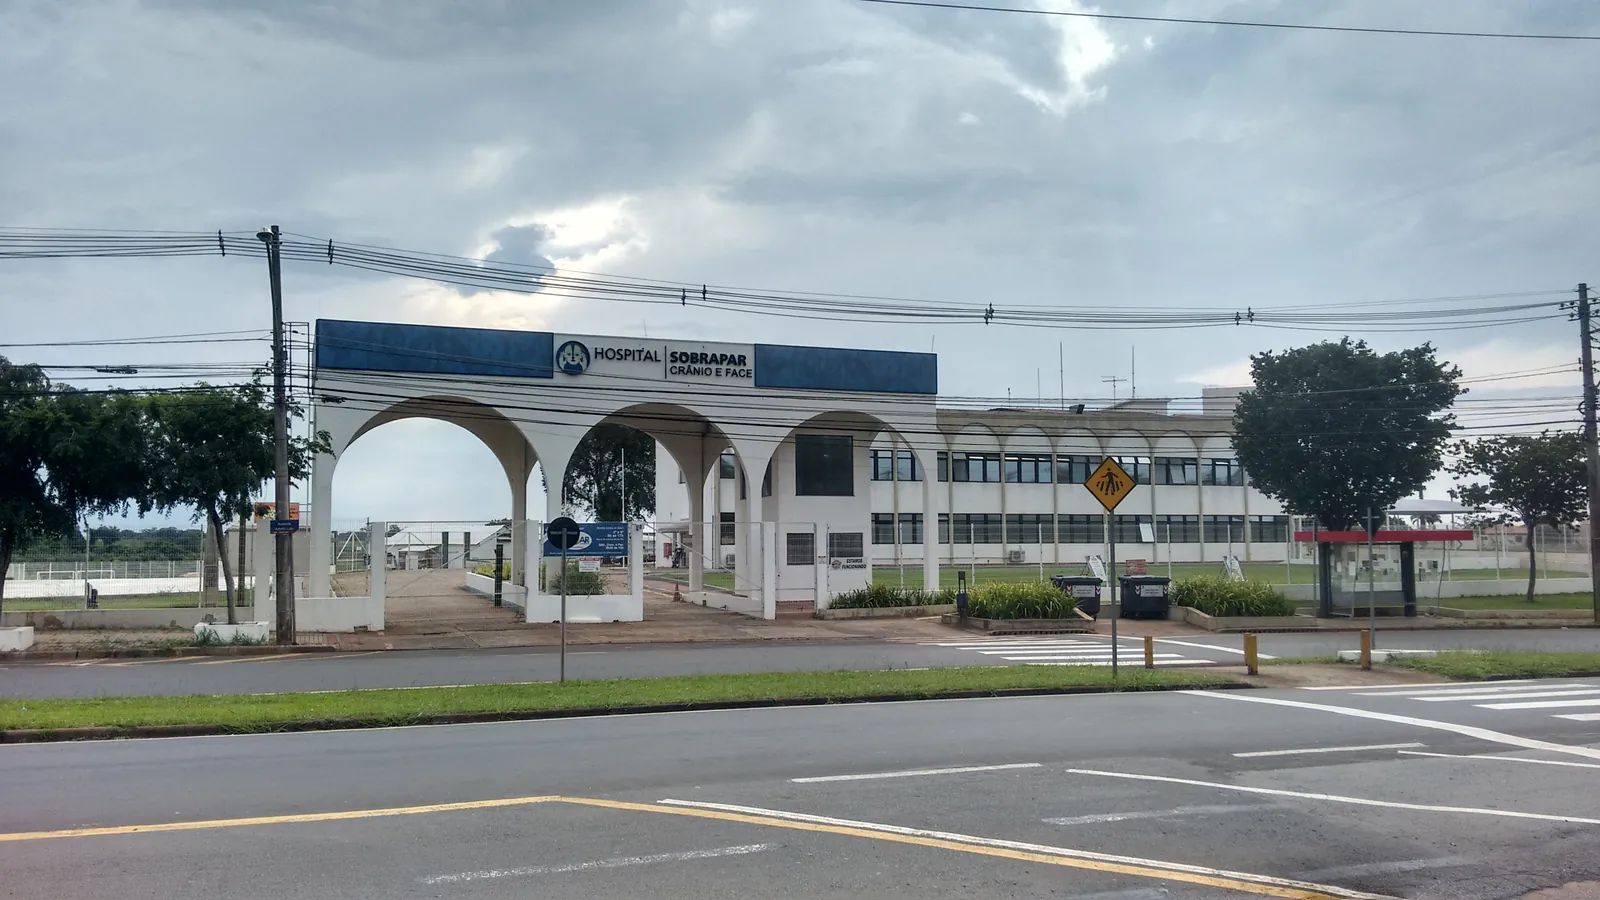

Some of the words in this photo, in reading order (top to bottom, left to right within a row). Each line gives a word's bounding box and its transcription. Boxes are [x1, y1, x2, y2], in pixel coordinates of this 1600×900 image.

[594, 347, 661, 362] HOSPITAL
[670, 351, 747, 366] SOBRAPAR
[669, 365, 713, 377] CRÂNIO
[716, 367, 723, 377] E
[725, 368, 753, 378] FACE
